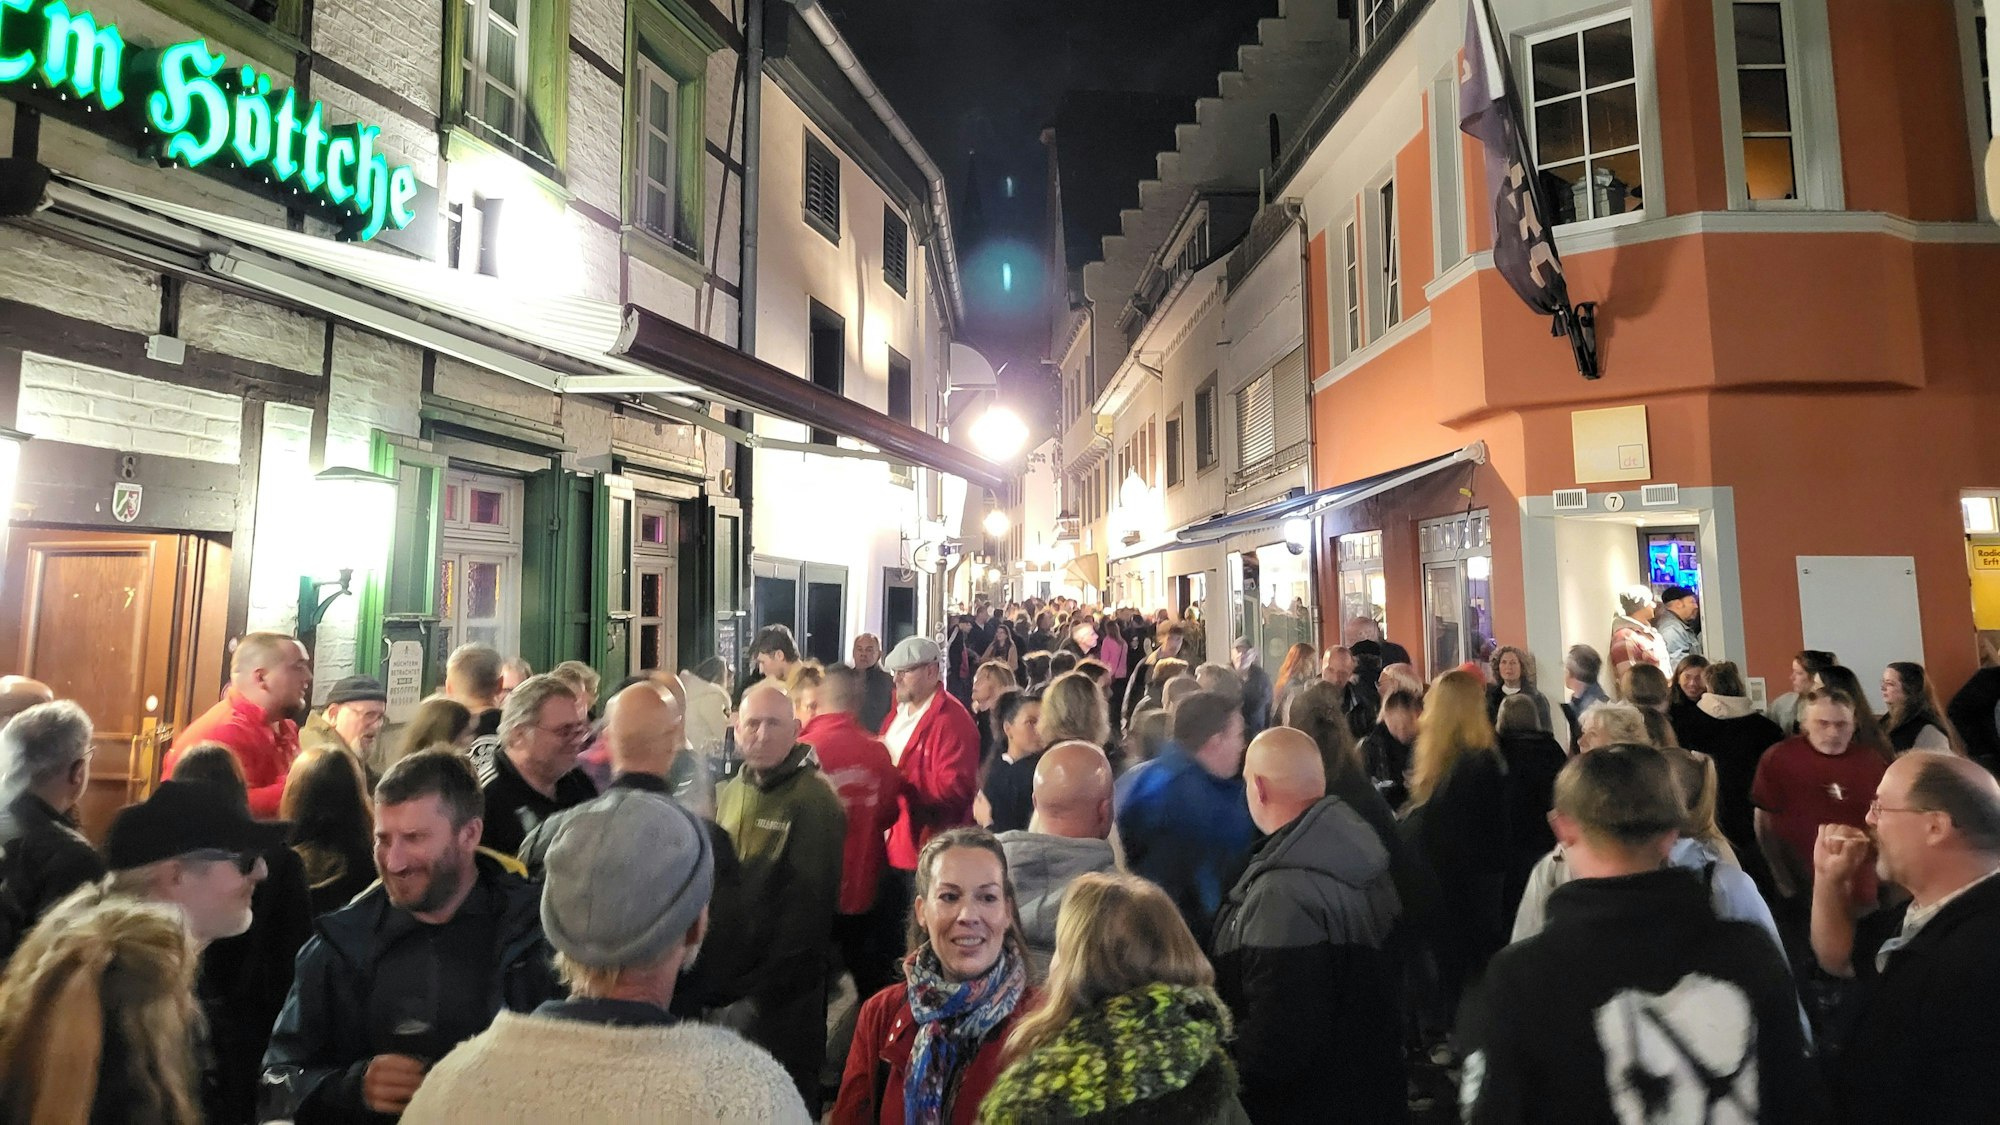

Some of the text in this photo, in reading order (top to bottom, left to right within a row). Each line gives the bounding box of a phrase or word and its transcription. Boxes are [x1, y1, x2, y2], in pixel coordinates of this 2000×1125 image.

[147, 39, 417, 242] Höttche
[122, 455, 136, 480] 8
[1610, 496, 1617, 507] 7
